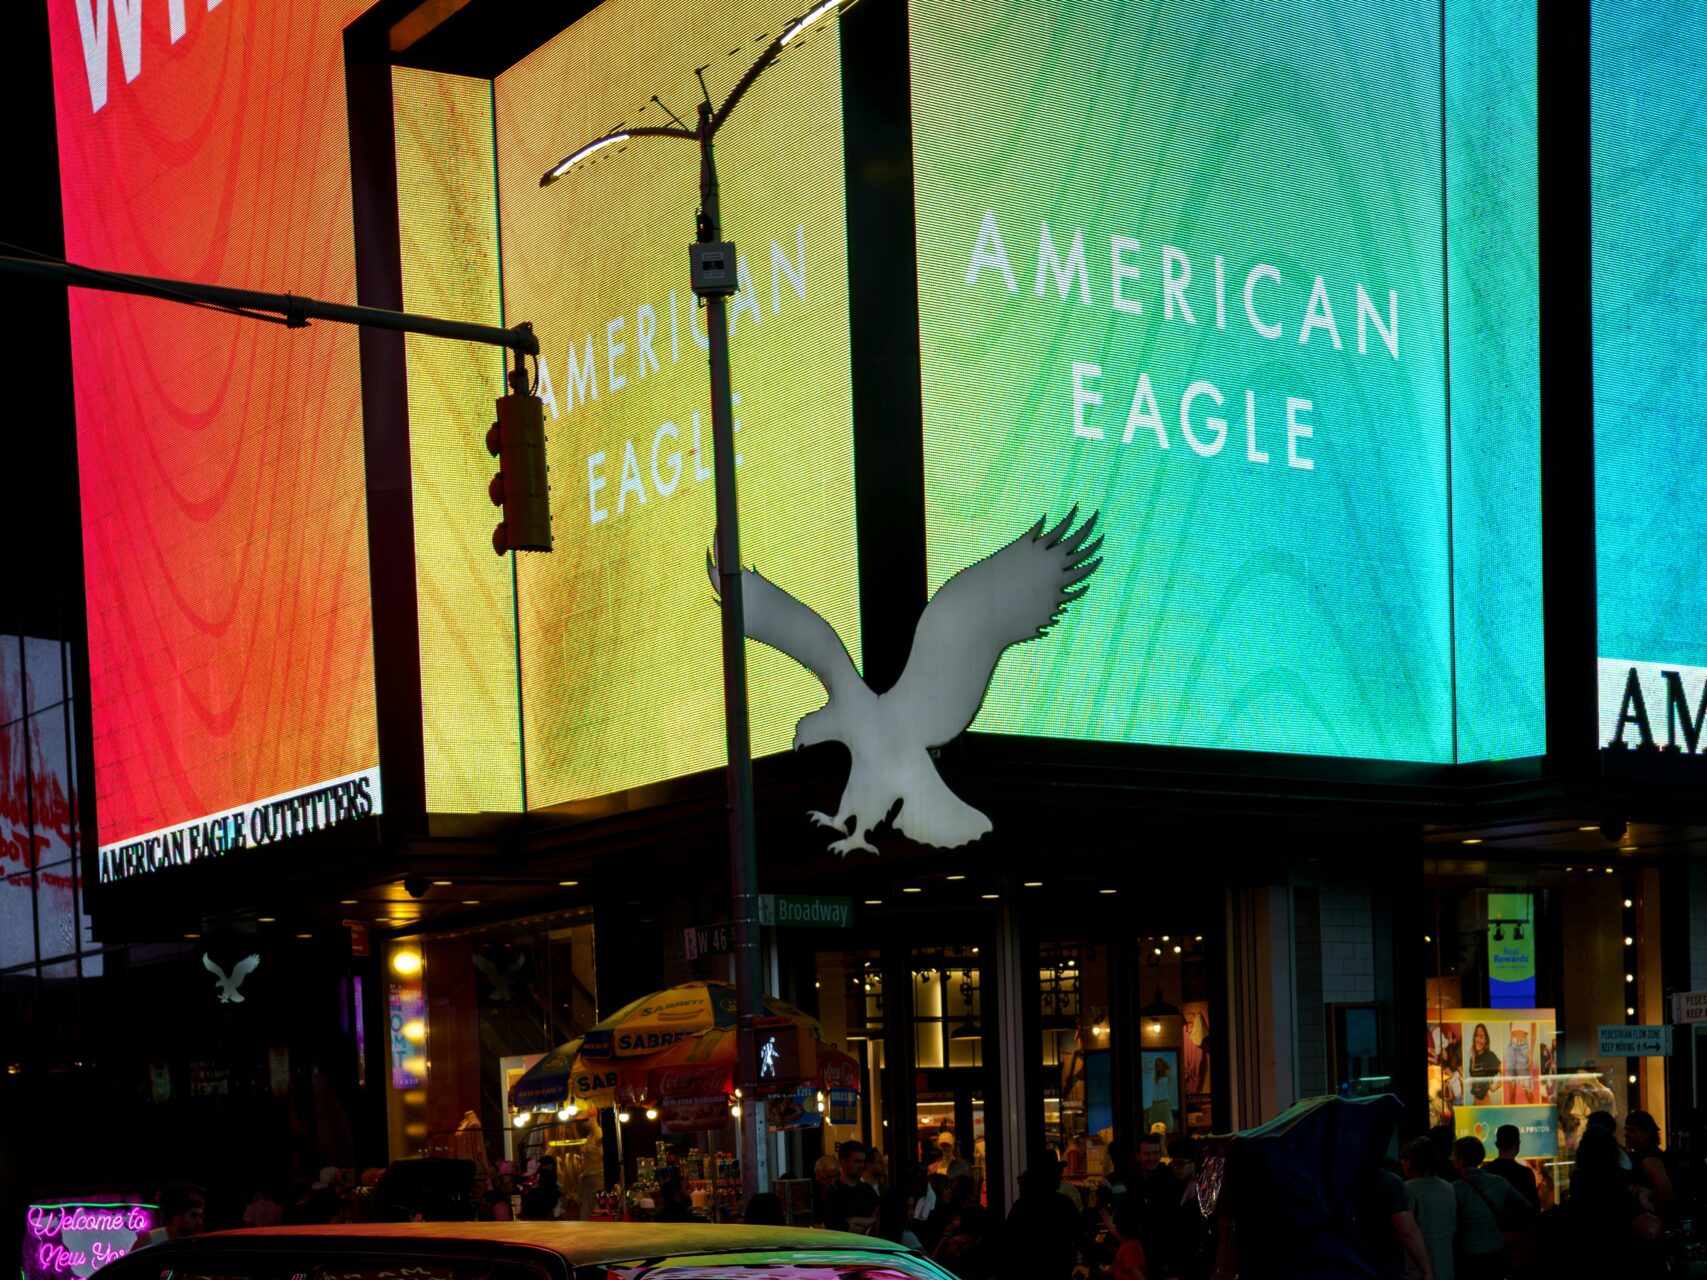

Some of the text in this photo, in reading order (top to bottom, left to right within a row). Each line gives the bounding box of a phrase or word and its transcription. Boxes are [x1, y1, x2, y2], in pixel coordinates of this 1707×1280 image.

[964, 209, 1400, 362] AMERICAN
[1071, 360, 1316, 471] EAGLE
[100, 775, 373, 885] AMERICAN EAGLE OUTFITTERS
[779, 899, 848, 927] Broadway
[697, 930, 708, 954] W
[712, 928, 727, 950] 46
[1494, 954, 1529, 963] Rewards
[1600, 1029, 1632, 1039] PEDESTRIAN
[1632, 1030, 1646, 1039] FLOW
[1600, 1042, 1635, 1052] KEEP MOVING
[28, 1207, 146, 1236] Welcome to
[39, 1243, 87, 1272] New
